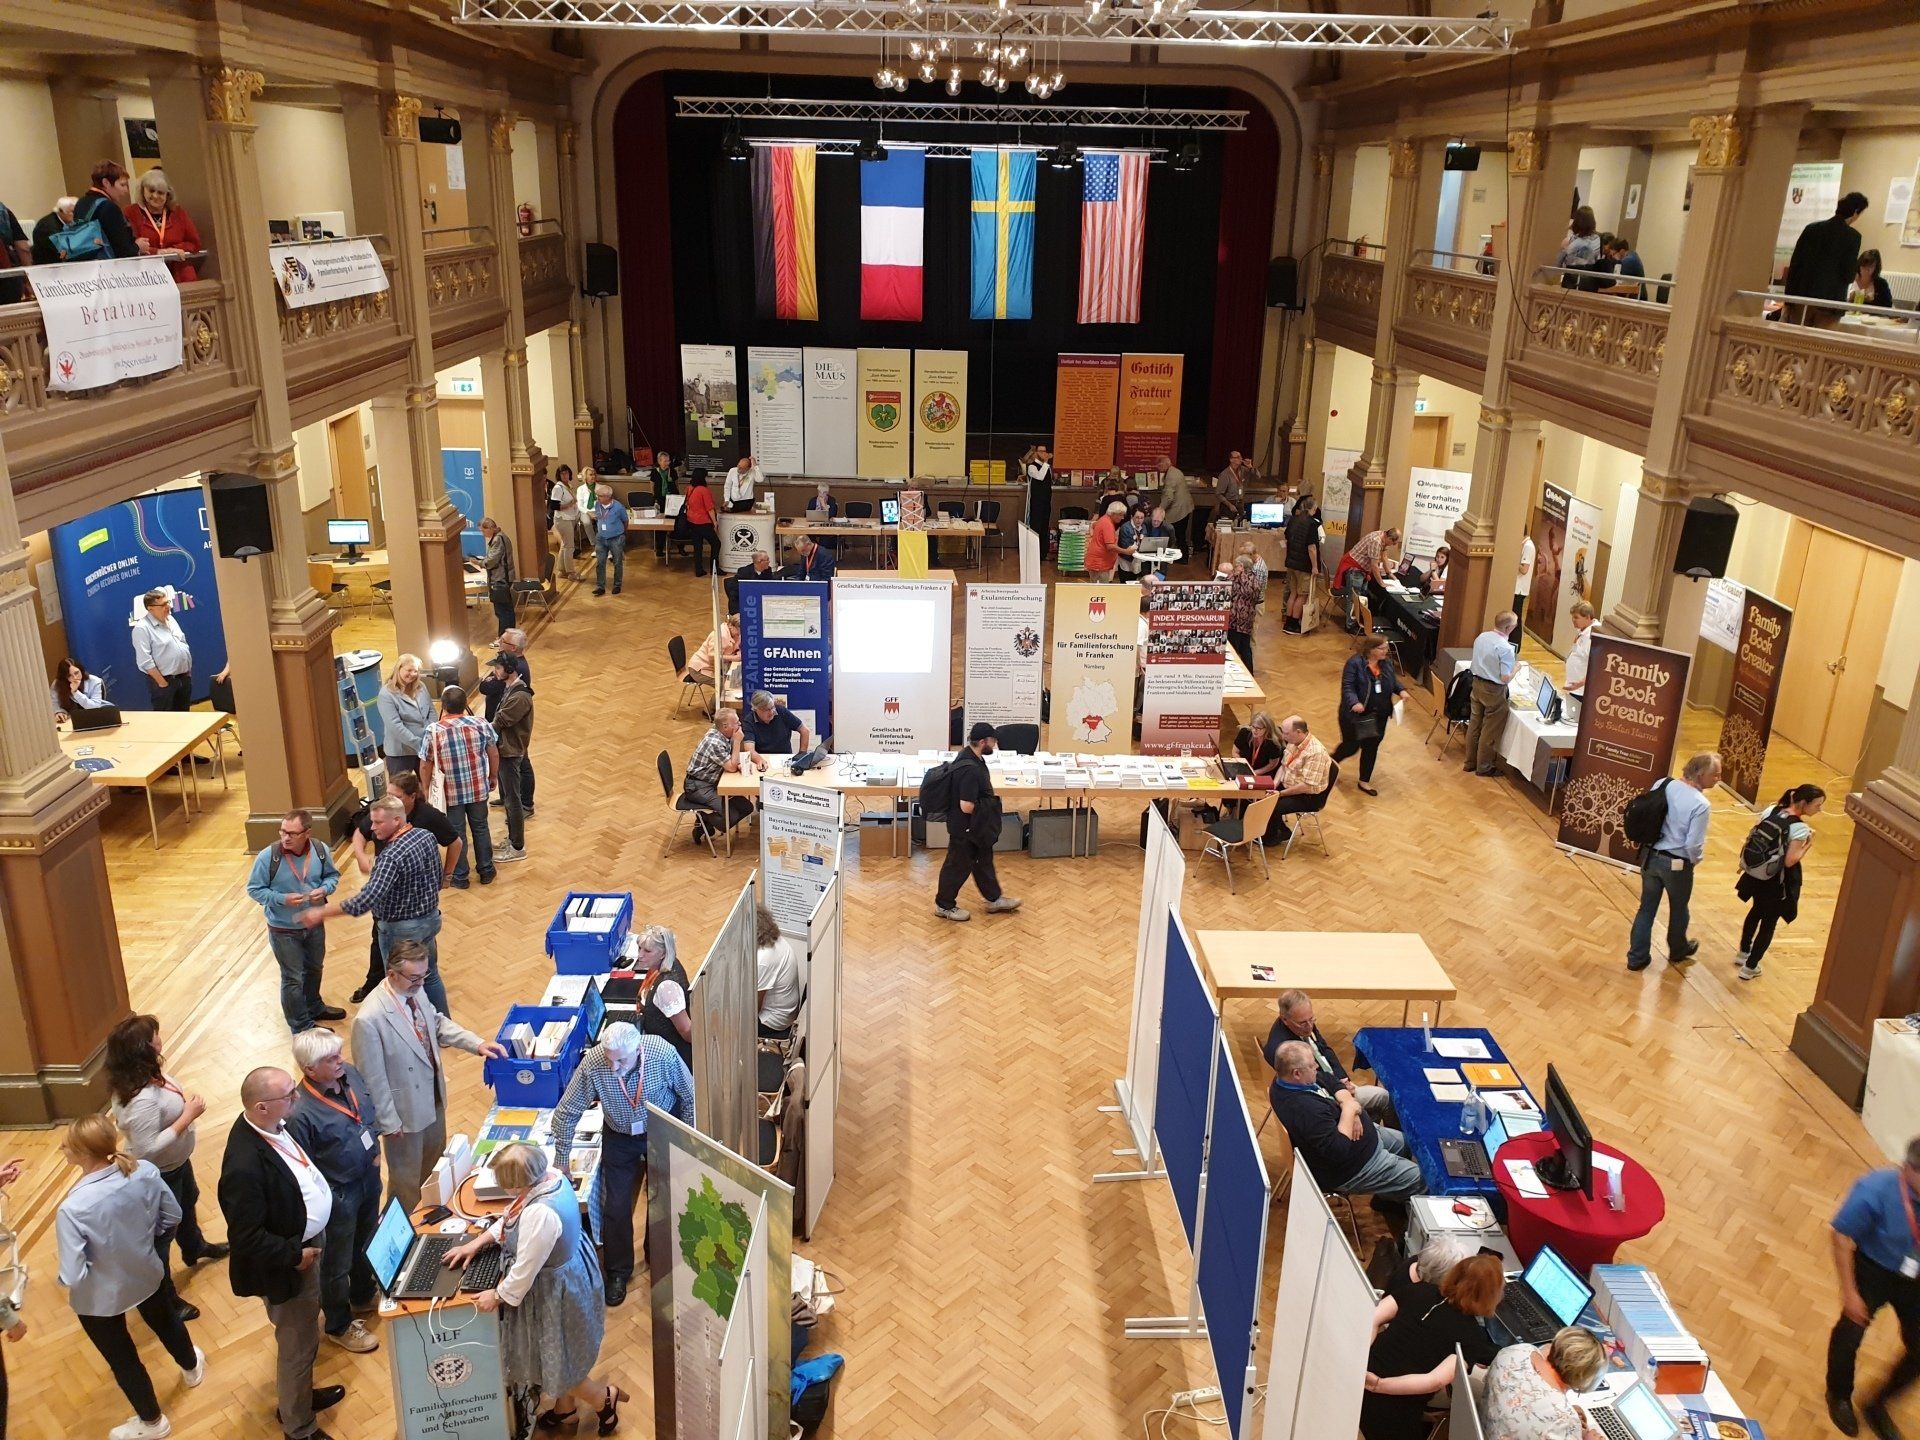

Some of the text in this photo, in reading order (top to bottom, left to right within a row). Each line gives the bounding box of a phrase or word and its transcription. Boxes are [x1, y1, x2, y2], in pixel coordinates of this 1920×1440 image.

[35, 270, 168, 299] Familiengeschichtskundliche
[80, 300, 157, 326] Beratung
[815, 362, 832, 371] DIE
[815, 372, 846, 380] MAUS
[1130, 386, 1172, 399] Fraktur
[1431, 494, 1461, 504] erhalten
[118, 556, 138, 570] ONLINE
[100, 574, 120, 588] RECORDS
[121, 566, 140, 580] ONLINE
[1748, 605, 1781, 639] Family
[1069, 642, 1134, 651] Familienforschung
[1748, 628, 1772, 655] Book
[764, 647, 822, 659] GFAhnen
[1741, 643, 1775, 676] Creator
[1604, 653, 1670, 688] Family
[1608, 677, 1657, 706] Book
[1595, 695, 1665, 728] Creator
[1594, 719, 1604, 729] by
[1605, 721, 1630, 735] Stefan
[1605, 746, 1619, 754] Family
[794, 796, 821, 806] Familienkunde
[802, 793, 830, 802] Landesverein
[769, 816, 832, 833] Bayerischer Landesverein
[781, 826, 818, 838] Familienkunde
[431, 1329, 461, 1344] BLF
[409, 1392, 498, 1415] Familienforschung
[438, 1406, 484, 1420] Altbayern
[421, 1414, 490, 1434] und Schwaben
